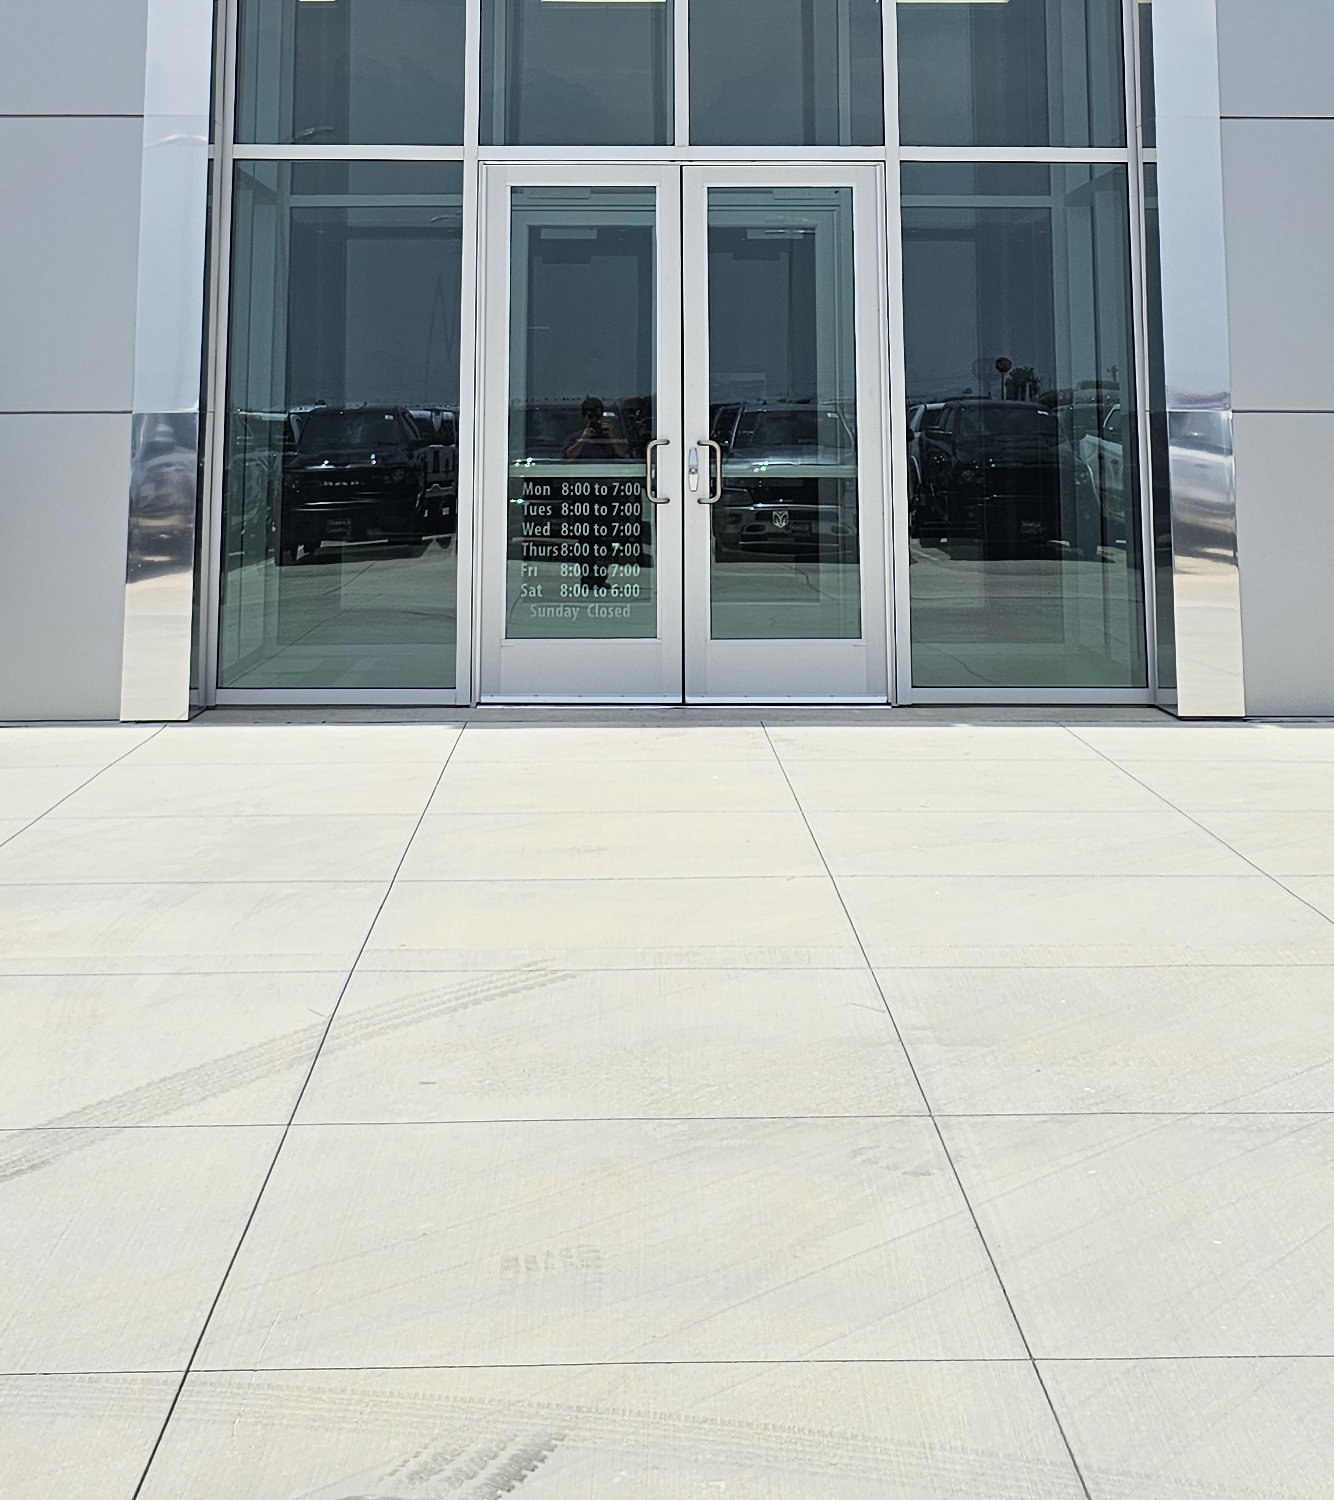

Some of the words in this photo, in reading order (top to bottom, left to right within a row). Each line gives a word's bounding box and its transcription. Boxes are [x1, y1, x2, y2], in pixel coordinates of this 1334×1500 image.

[522, 482, 551, 496] Mon
[561, 482, 591, 496] 8:00
[594, 483, 608, 496] to
[612, 482, 641, 496] 7:00
[523, 502, 552, 516] Tues
[561, 502, 590, 516] 8:00
[594, 503, 608, 516] to
[611, 502, 641, 516] 7:00
[522, 522, 551, 536] Wed
[560, 522, 590, 536] 8:00
[594, 523, 608, 536] to
[611, 522, 641, 536] 7:00
[522, 542, 558, 557] Thurs
[560, 542, 590, 557] 8:00
[594, 543, 608, 557] to
[611, 542, 641, 557] 7:00
[520, 563, 538, 577] Fri
[560, 563, 590, 577] 8:00
[594, 564, 608, 577] to
[610, 563, 641, 577] 7:00
[520, 584, 543, 598] Sat
[560, 583, 589, 598] 8:00
[594, 584, 608, 598] to
[610, 583, 640, 598] 6:00
[530, 604, 580, 621] Sunday
[587, 604, 631, 618] Closed
